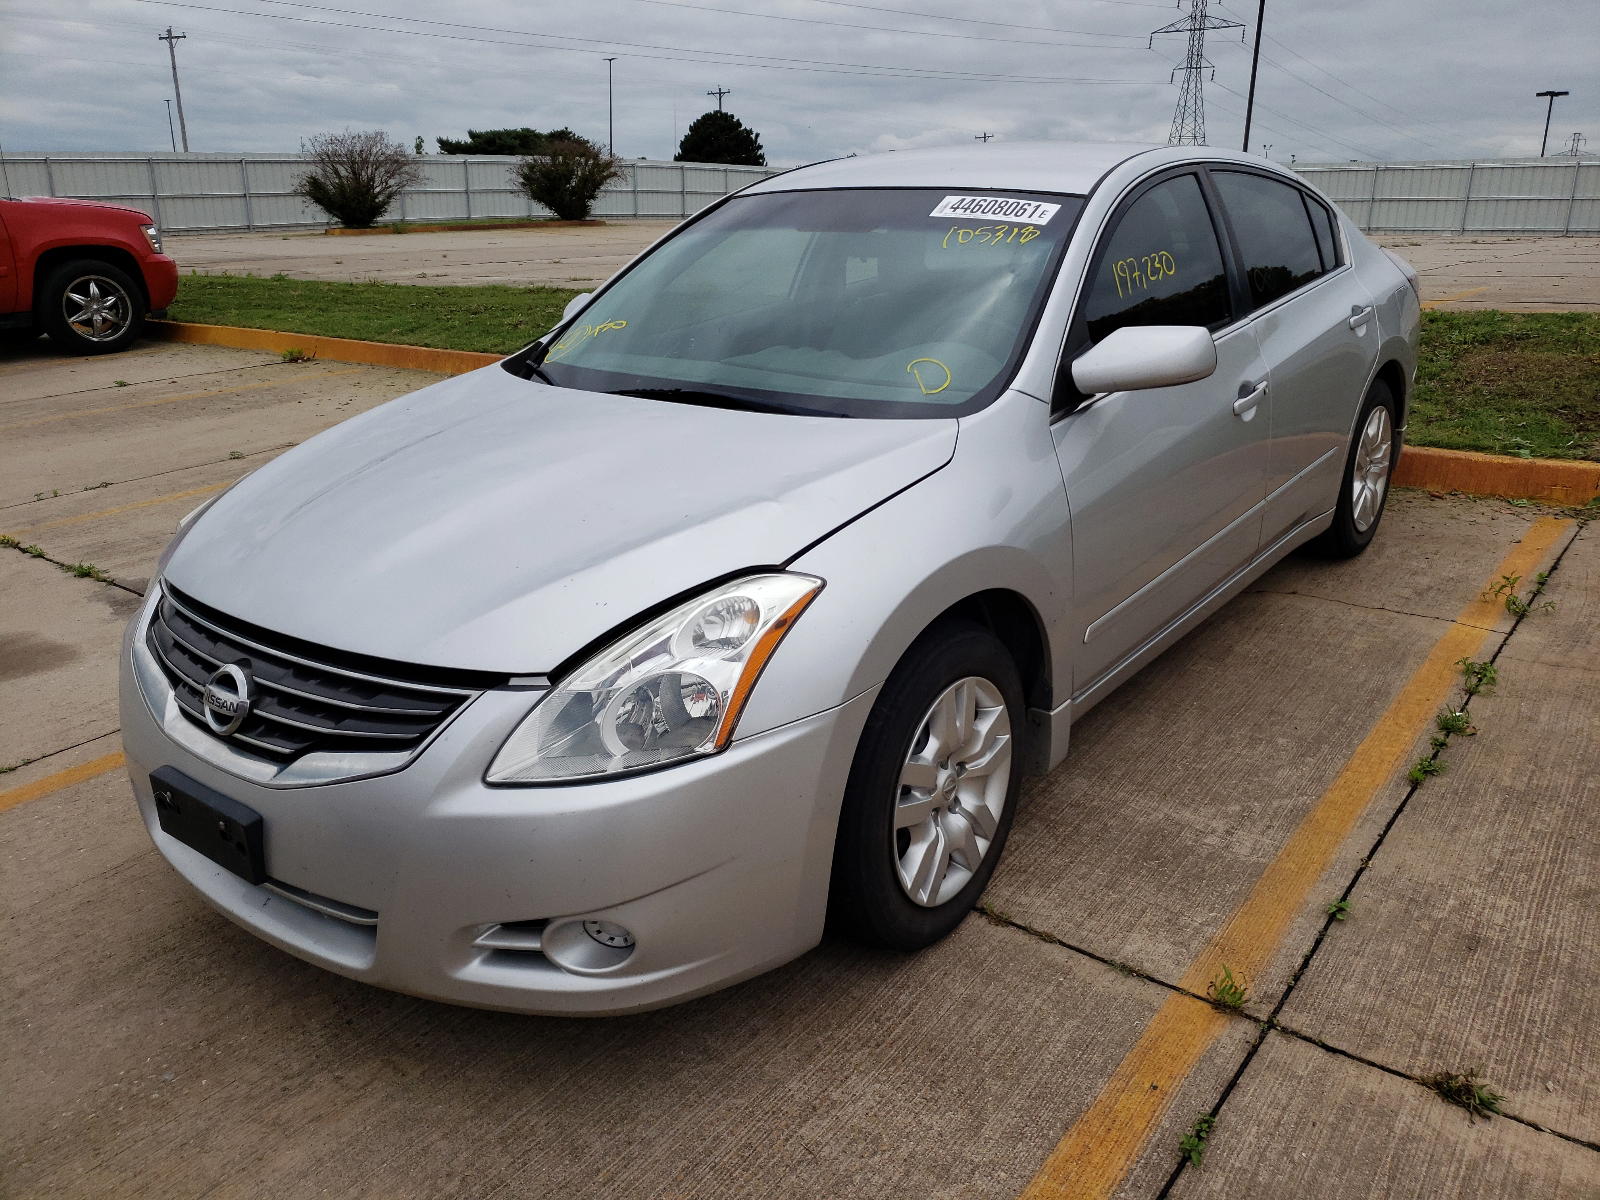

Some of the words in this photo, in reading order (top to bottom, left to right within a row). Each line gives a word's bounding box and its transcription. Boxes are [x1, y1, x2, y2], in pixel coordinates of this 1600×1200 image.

[949, 197, 1042, 218] 44608061
[1039, 209, 1050, 219] E
[206, 688, 239, 714] NISSAN
